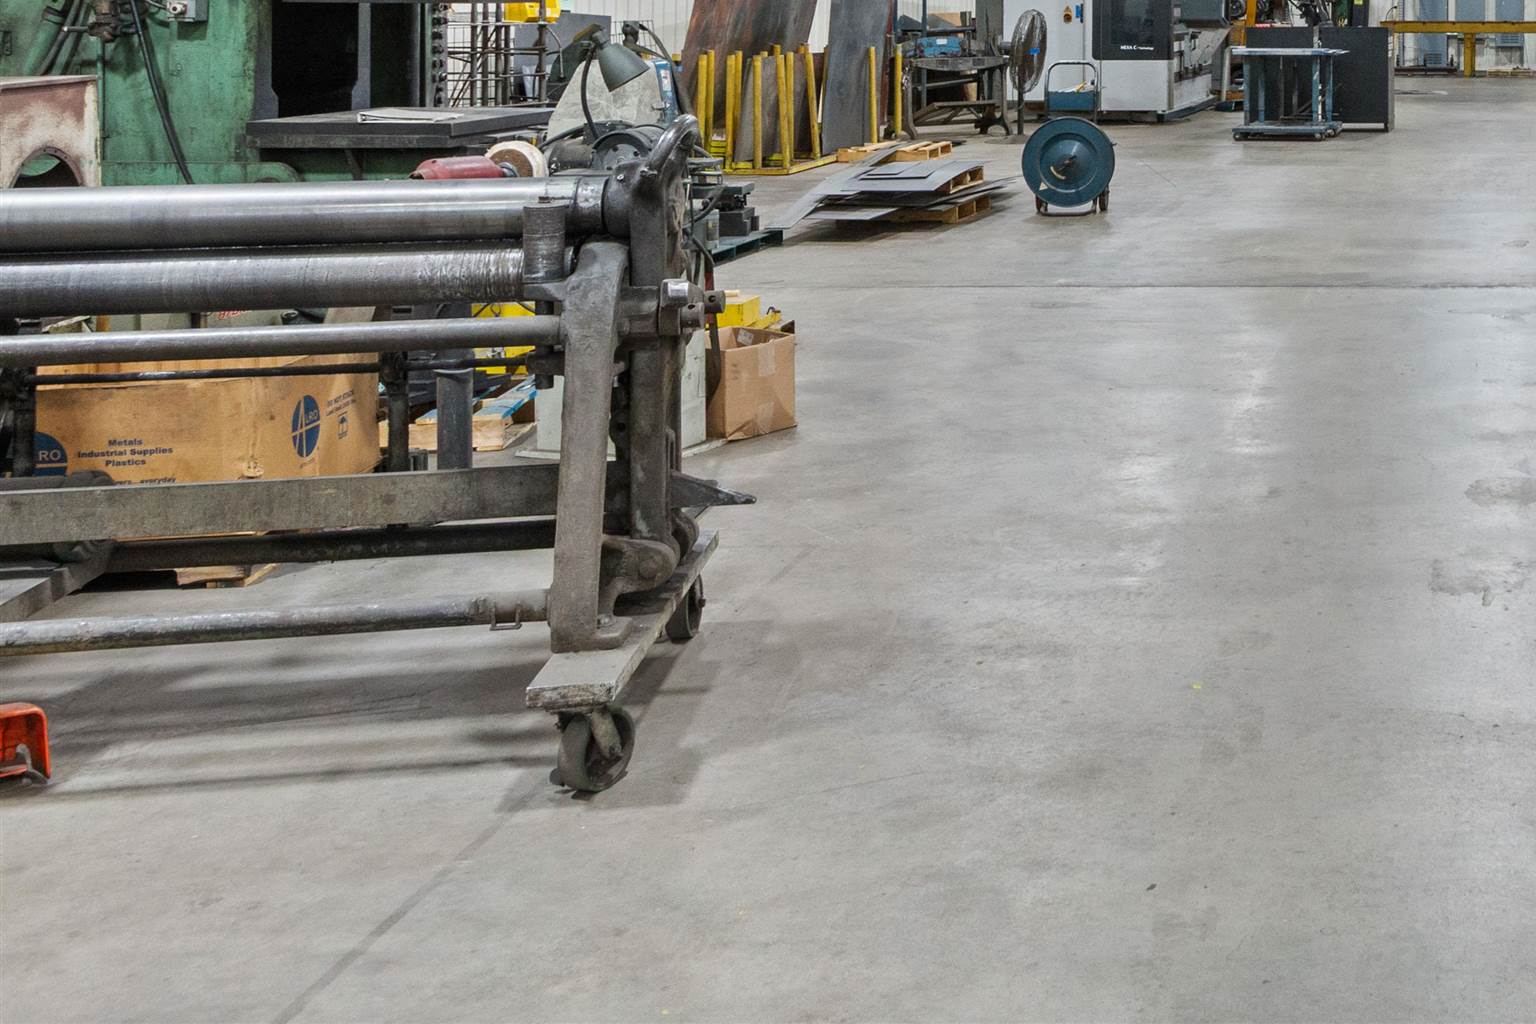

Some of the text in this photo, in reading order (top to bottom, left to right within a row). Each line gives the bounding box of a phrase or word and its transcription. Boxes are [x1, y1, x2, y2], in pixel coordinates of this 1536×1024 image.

[108, 438, 143, 448] Metals
[78, 446, 173, 458] Industrial Supplies
[105, 458, 146, 467] Plastics
